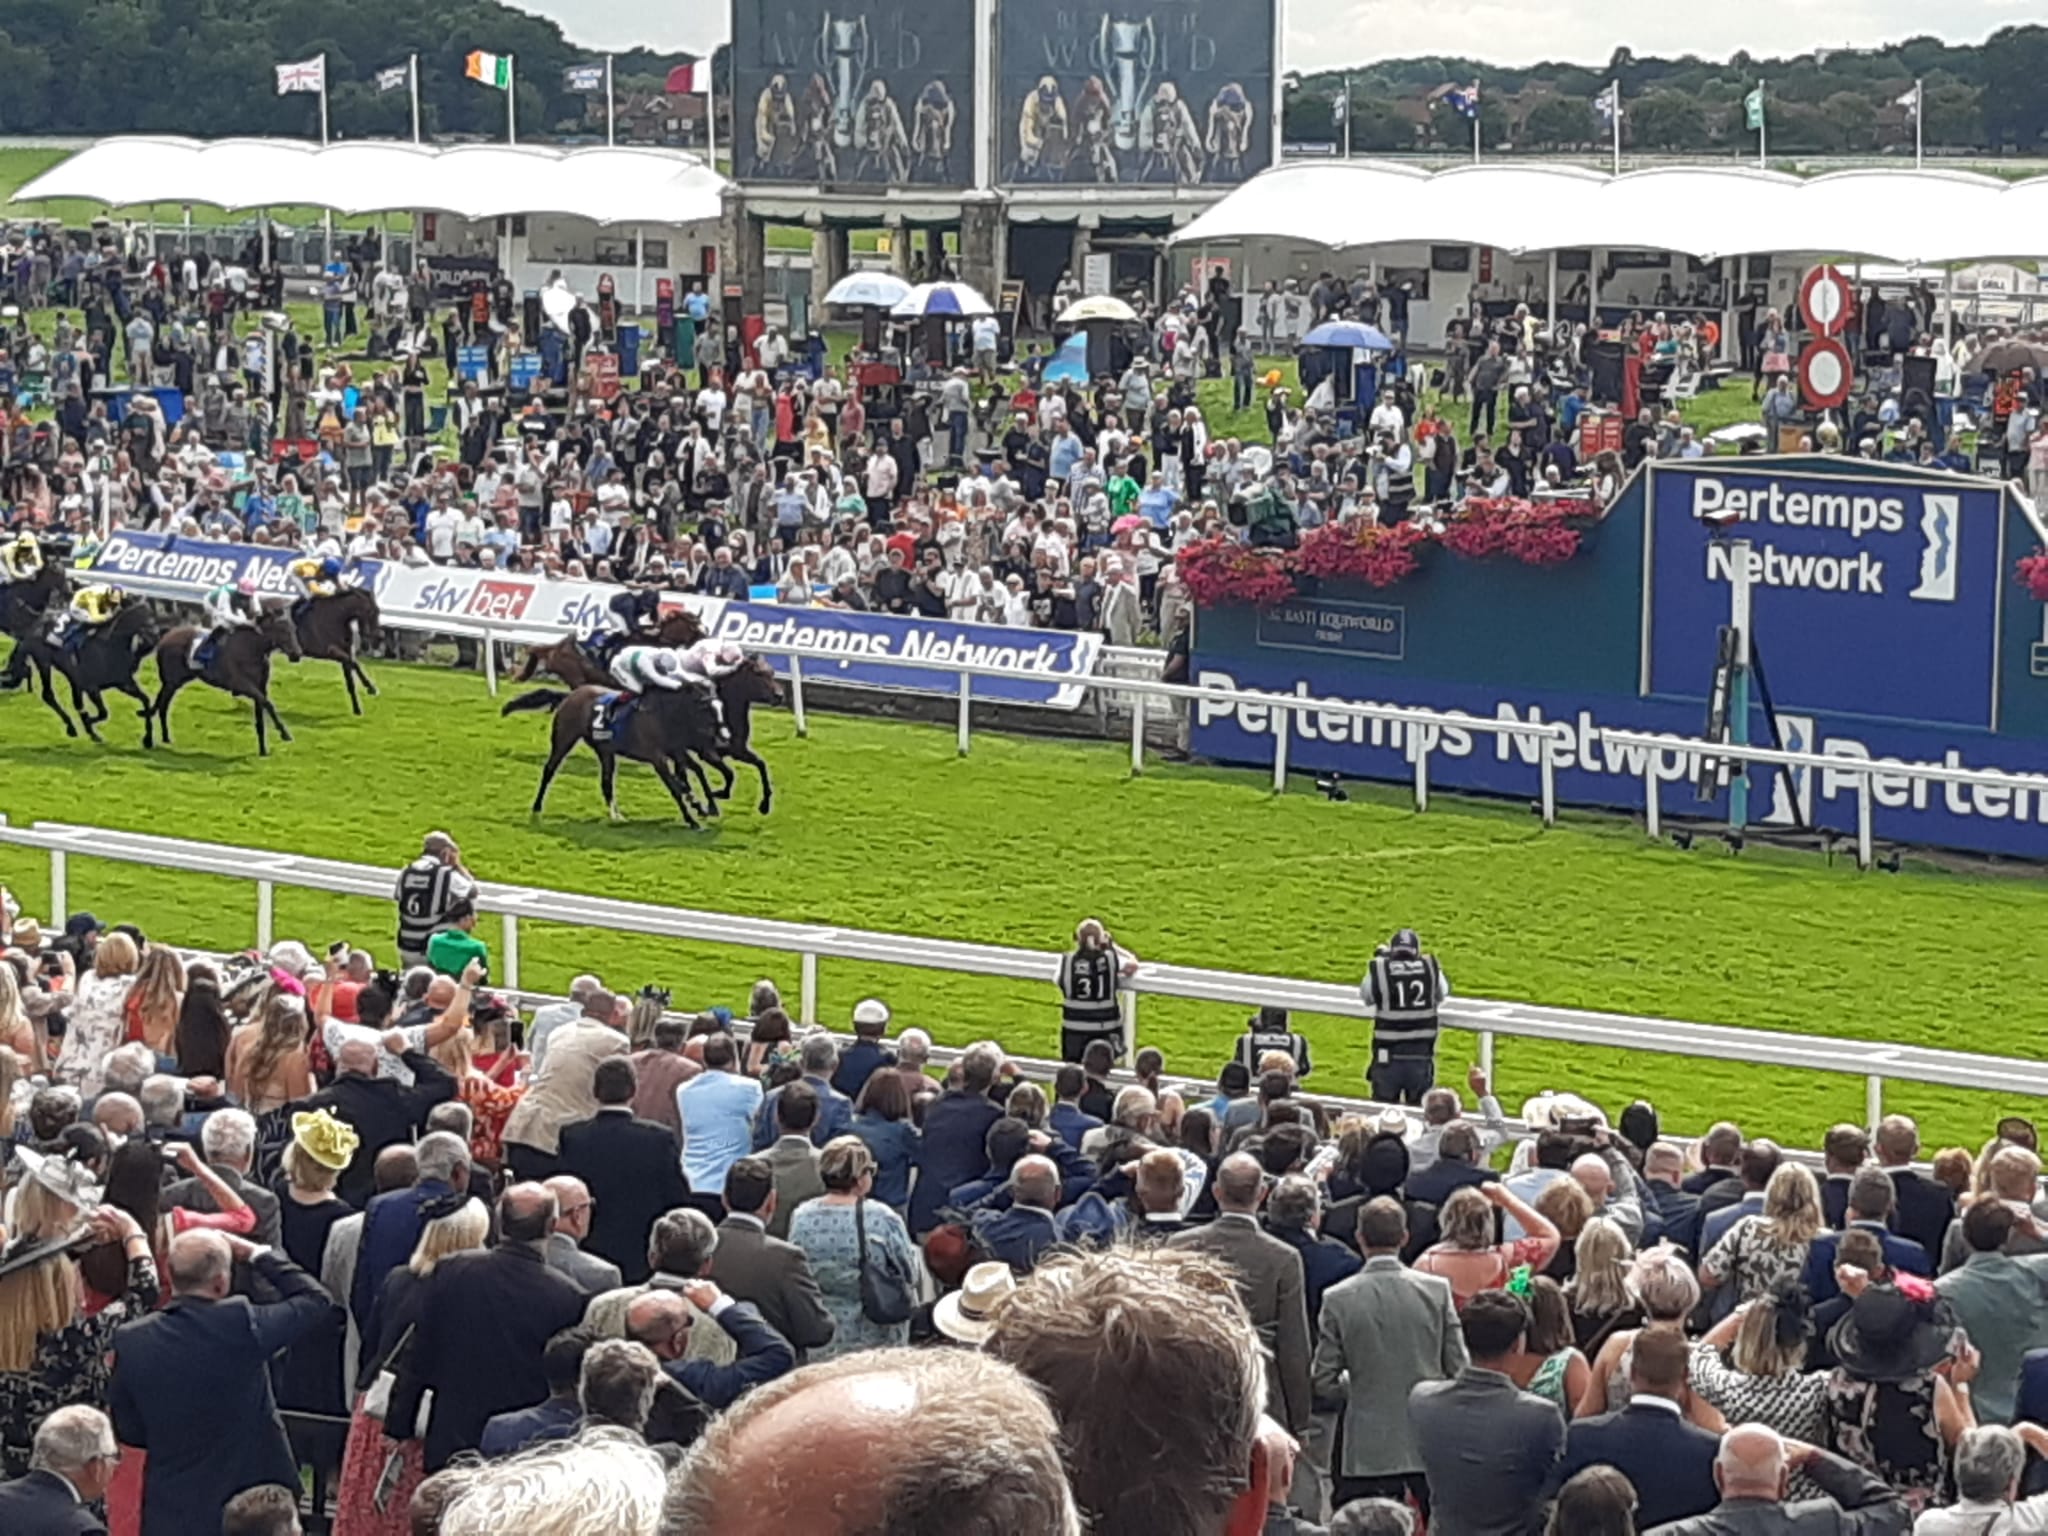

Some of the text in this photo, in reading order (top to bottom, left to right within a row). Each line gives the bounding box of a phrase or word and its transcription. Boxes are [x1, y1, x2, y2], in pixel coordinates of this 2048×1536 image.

[1693, 478, 1903, 537] Pertemps
[101, 538, 233, 583] Pertemps
[1707, 545, 1883, 593] Network
[717, 611, 1060, 673] Pertemps Network
[592, 704, 606, 729] 2
[407, 892, 420, 916] 6
[1076, 973, 1105, 999] 31
[1396, 980, 1426, 1008] 12
